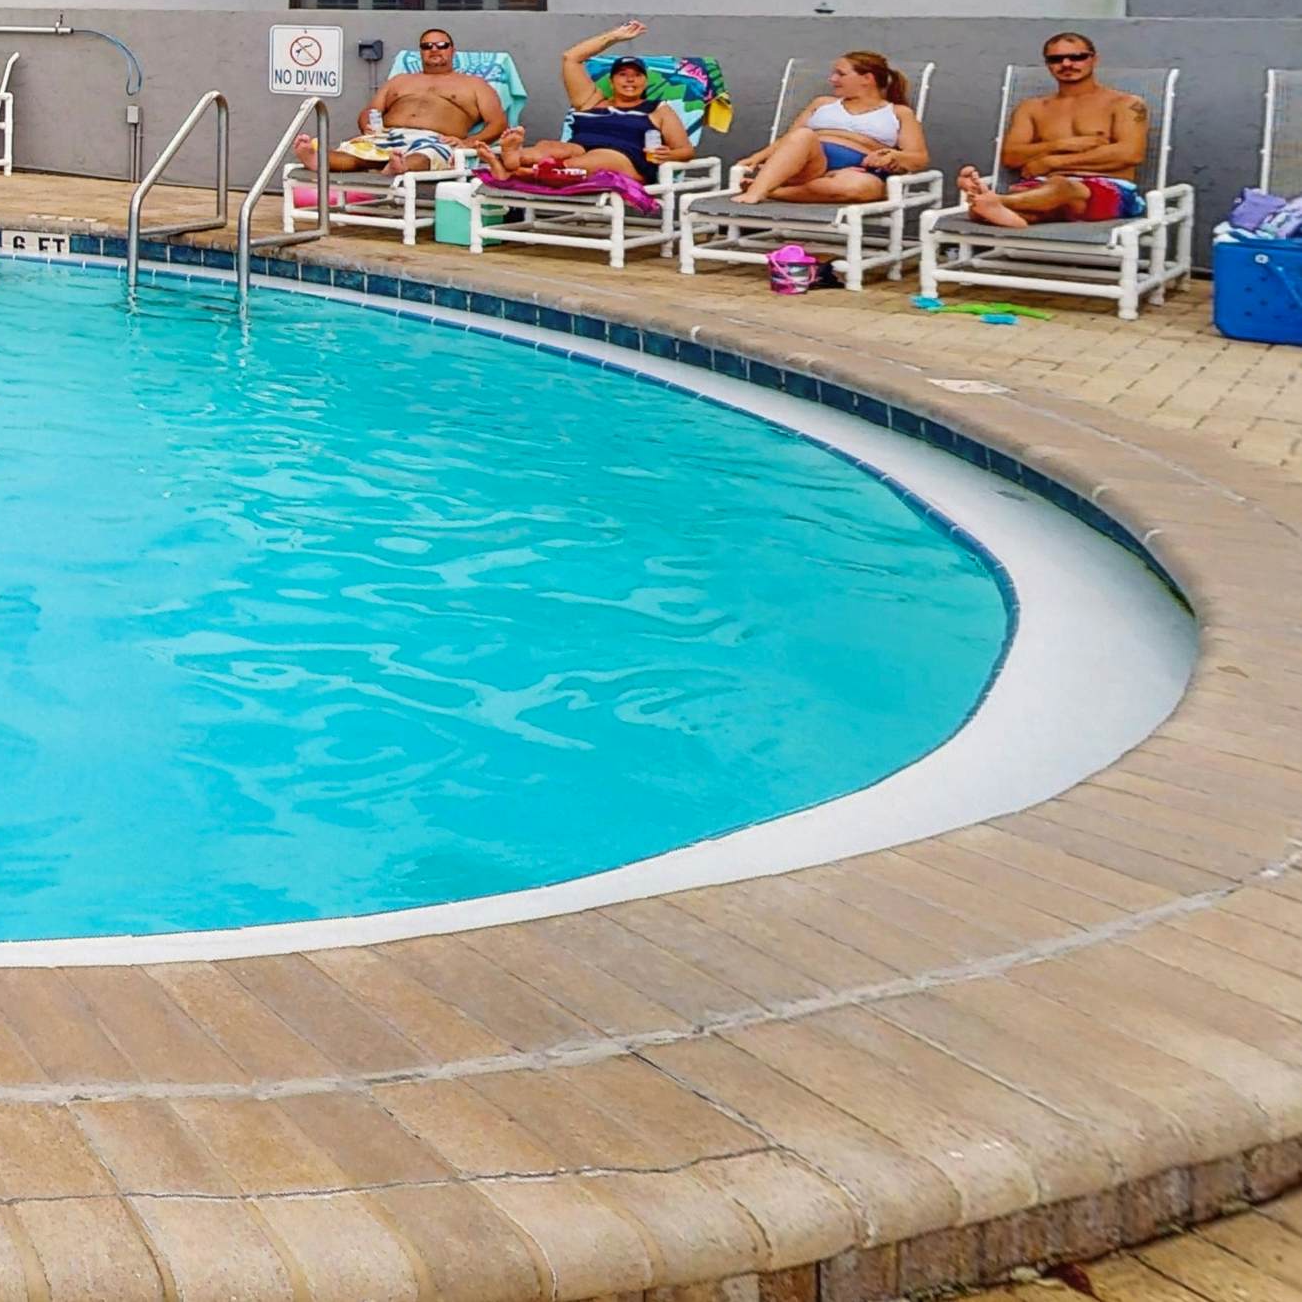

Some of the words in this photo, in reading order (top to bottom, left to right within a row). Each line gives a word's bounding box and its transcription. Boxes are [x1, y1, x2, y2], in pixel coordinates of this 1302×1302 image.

[275, 69, 292, 84] NO
[296, 70, 336, 87] DIVING
[38, 237, 65, 253] FT
